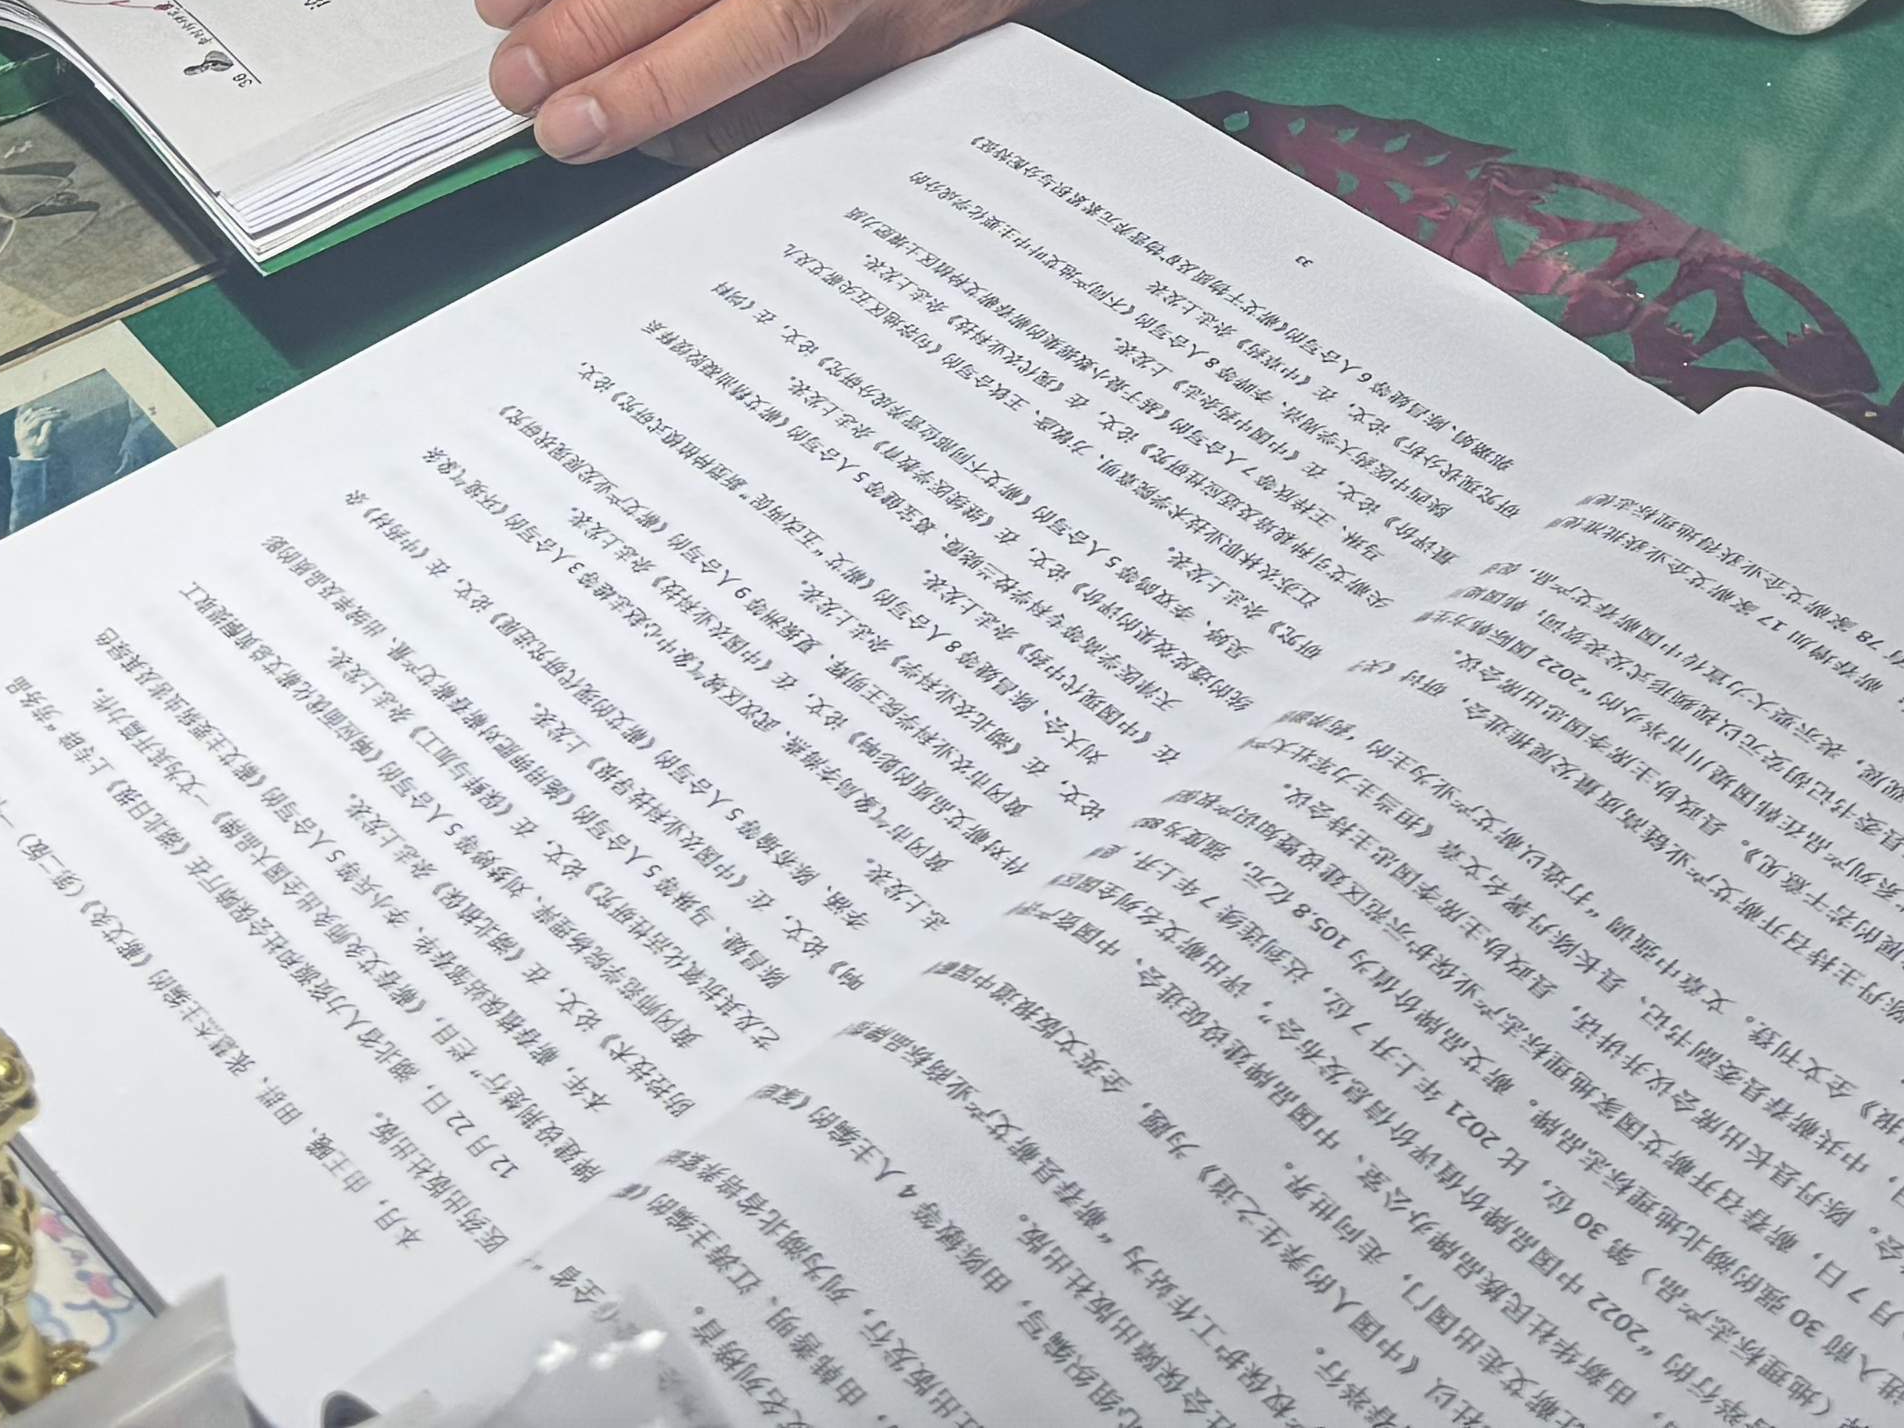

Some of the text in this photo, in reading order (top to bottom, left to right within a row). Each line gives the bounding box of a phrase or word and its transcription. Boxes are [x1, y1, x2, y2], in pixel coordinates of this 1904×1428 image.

[232, 71, 254, 87] 36
[1293, 254, 1314, 267] 33
[910, 565, 1181, 769] 在《中国现代中药》杂志上发表。
[1157, 542, 1326, 662] 研究》杂志上发表。
[786, 576, 1107, 824] 论文，在《湖北农业科学》杂志上发表。
[518, 698, 869, 997] 响》论文，在《中国农业科技导报》上发表。
[849, 851, 952, 936] 志上发表。
[333, 788, 696, 1122] 防控技术》论文，在《湖北植保》杂志上发表。
[356, 1103, 512, 1259] 医药出版社出版。
[1303, 1344, 1408, 1428] 春举行。
